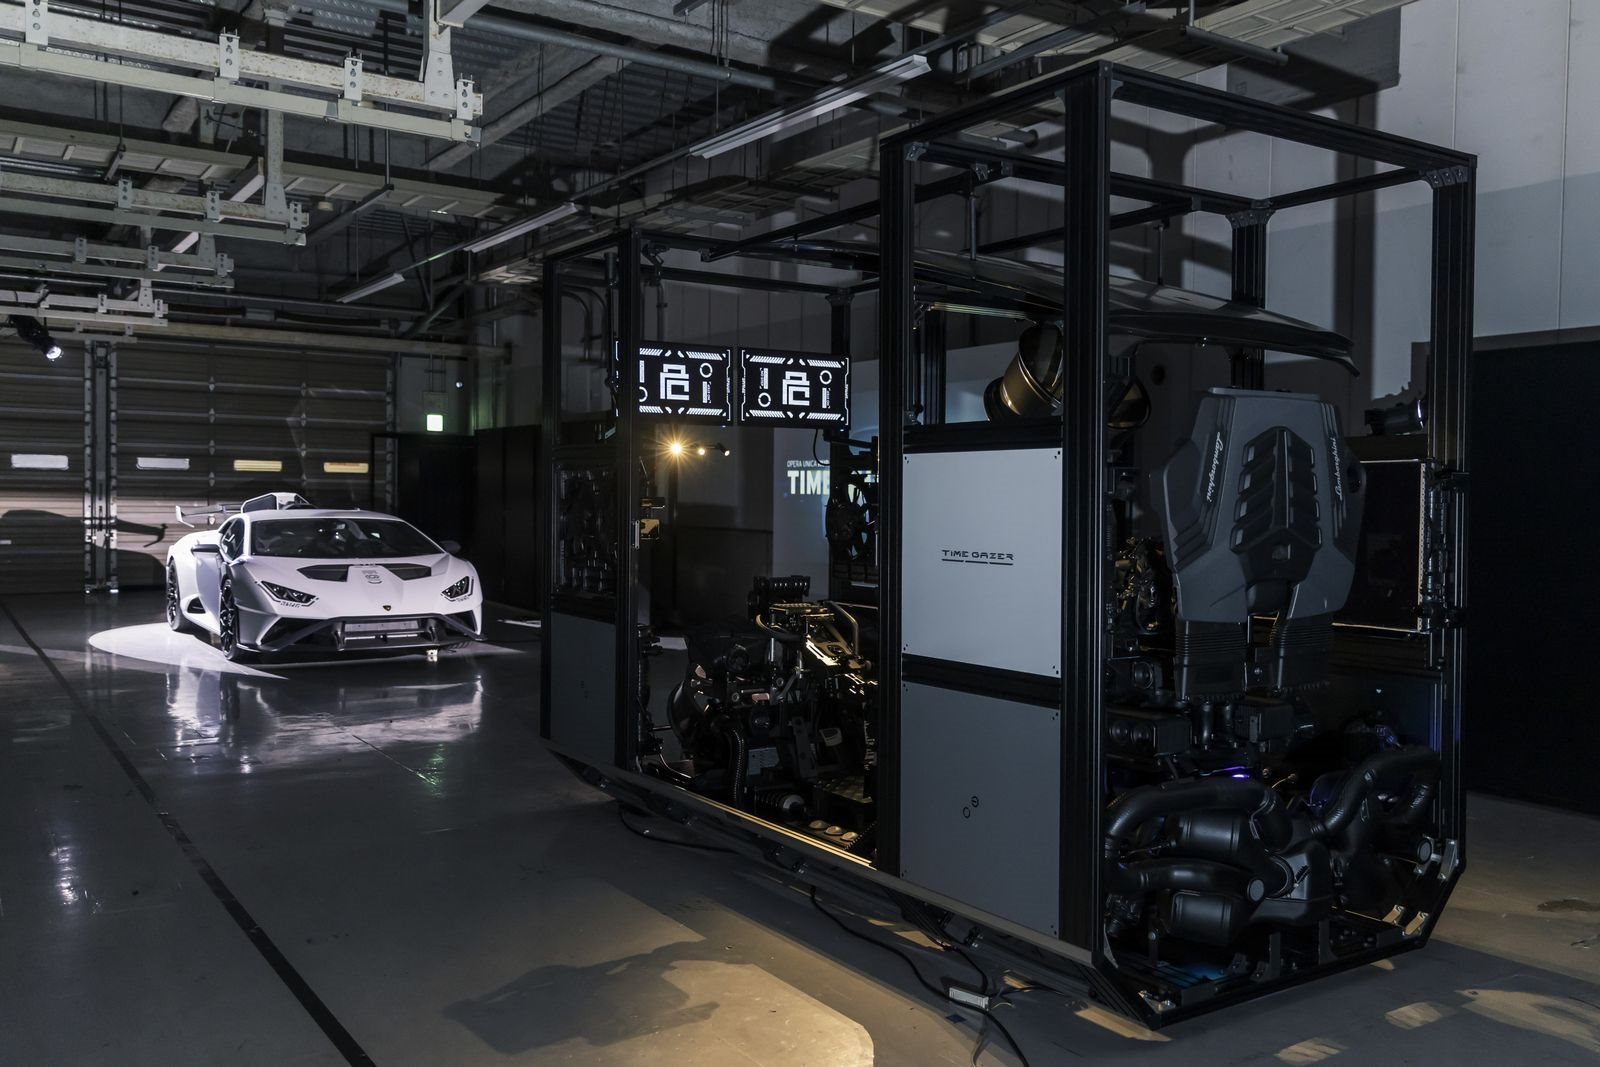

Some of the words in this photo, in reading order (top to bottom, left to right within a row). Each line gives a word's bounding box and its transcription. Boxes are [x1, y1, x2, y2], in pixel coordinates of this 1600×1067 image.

[1206, 431, 1223, 503] Lamborghini
[1330, 437, 1343, 501] Lamborghini
[942, 549, 969, 557] TIME
[971, 551, 1014, 561] GAZER
